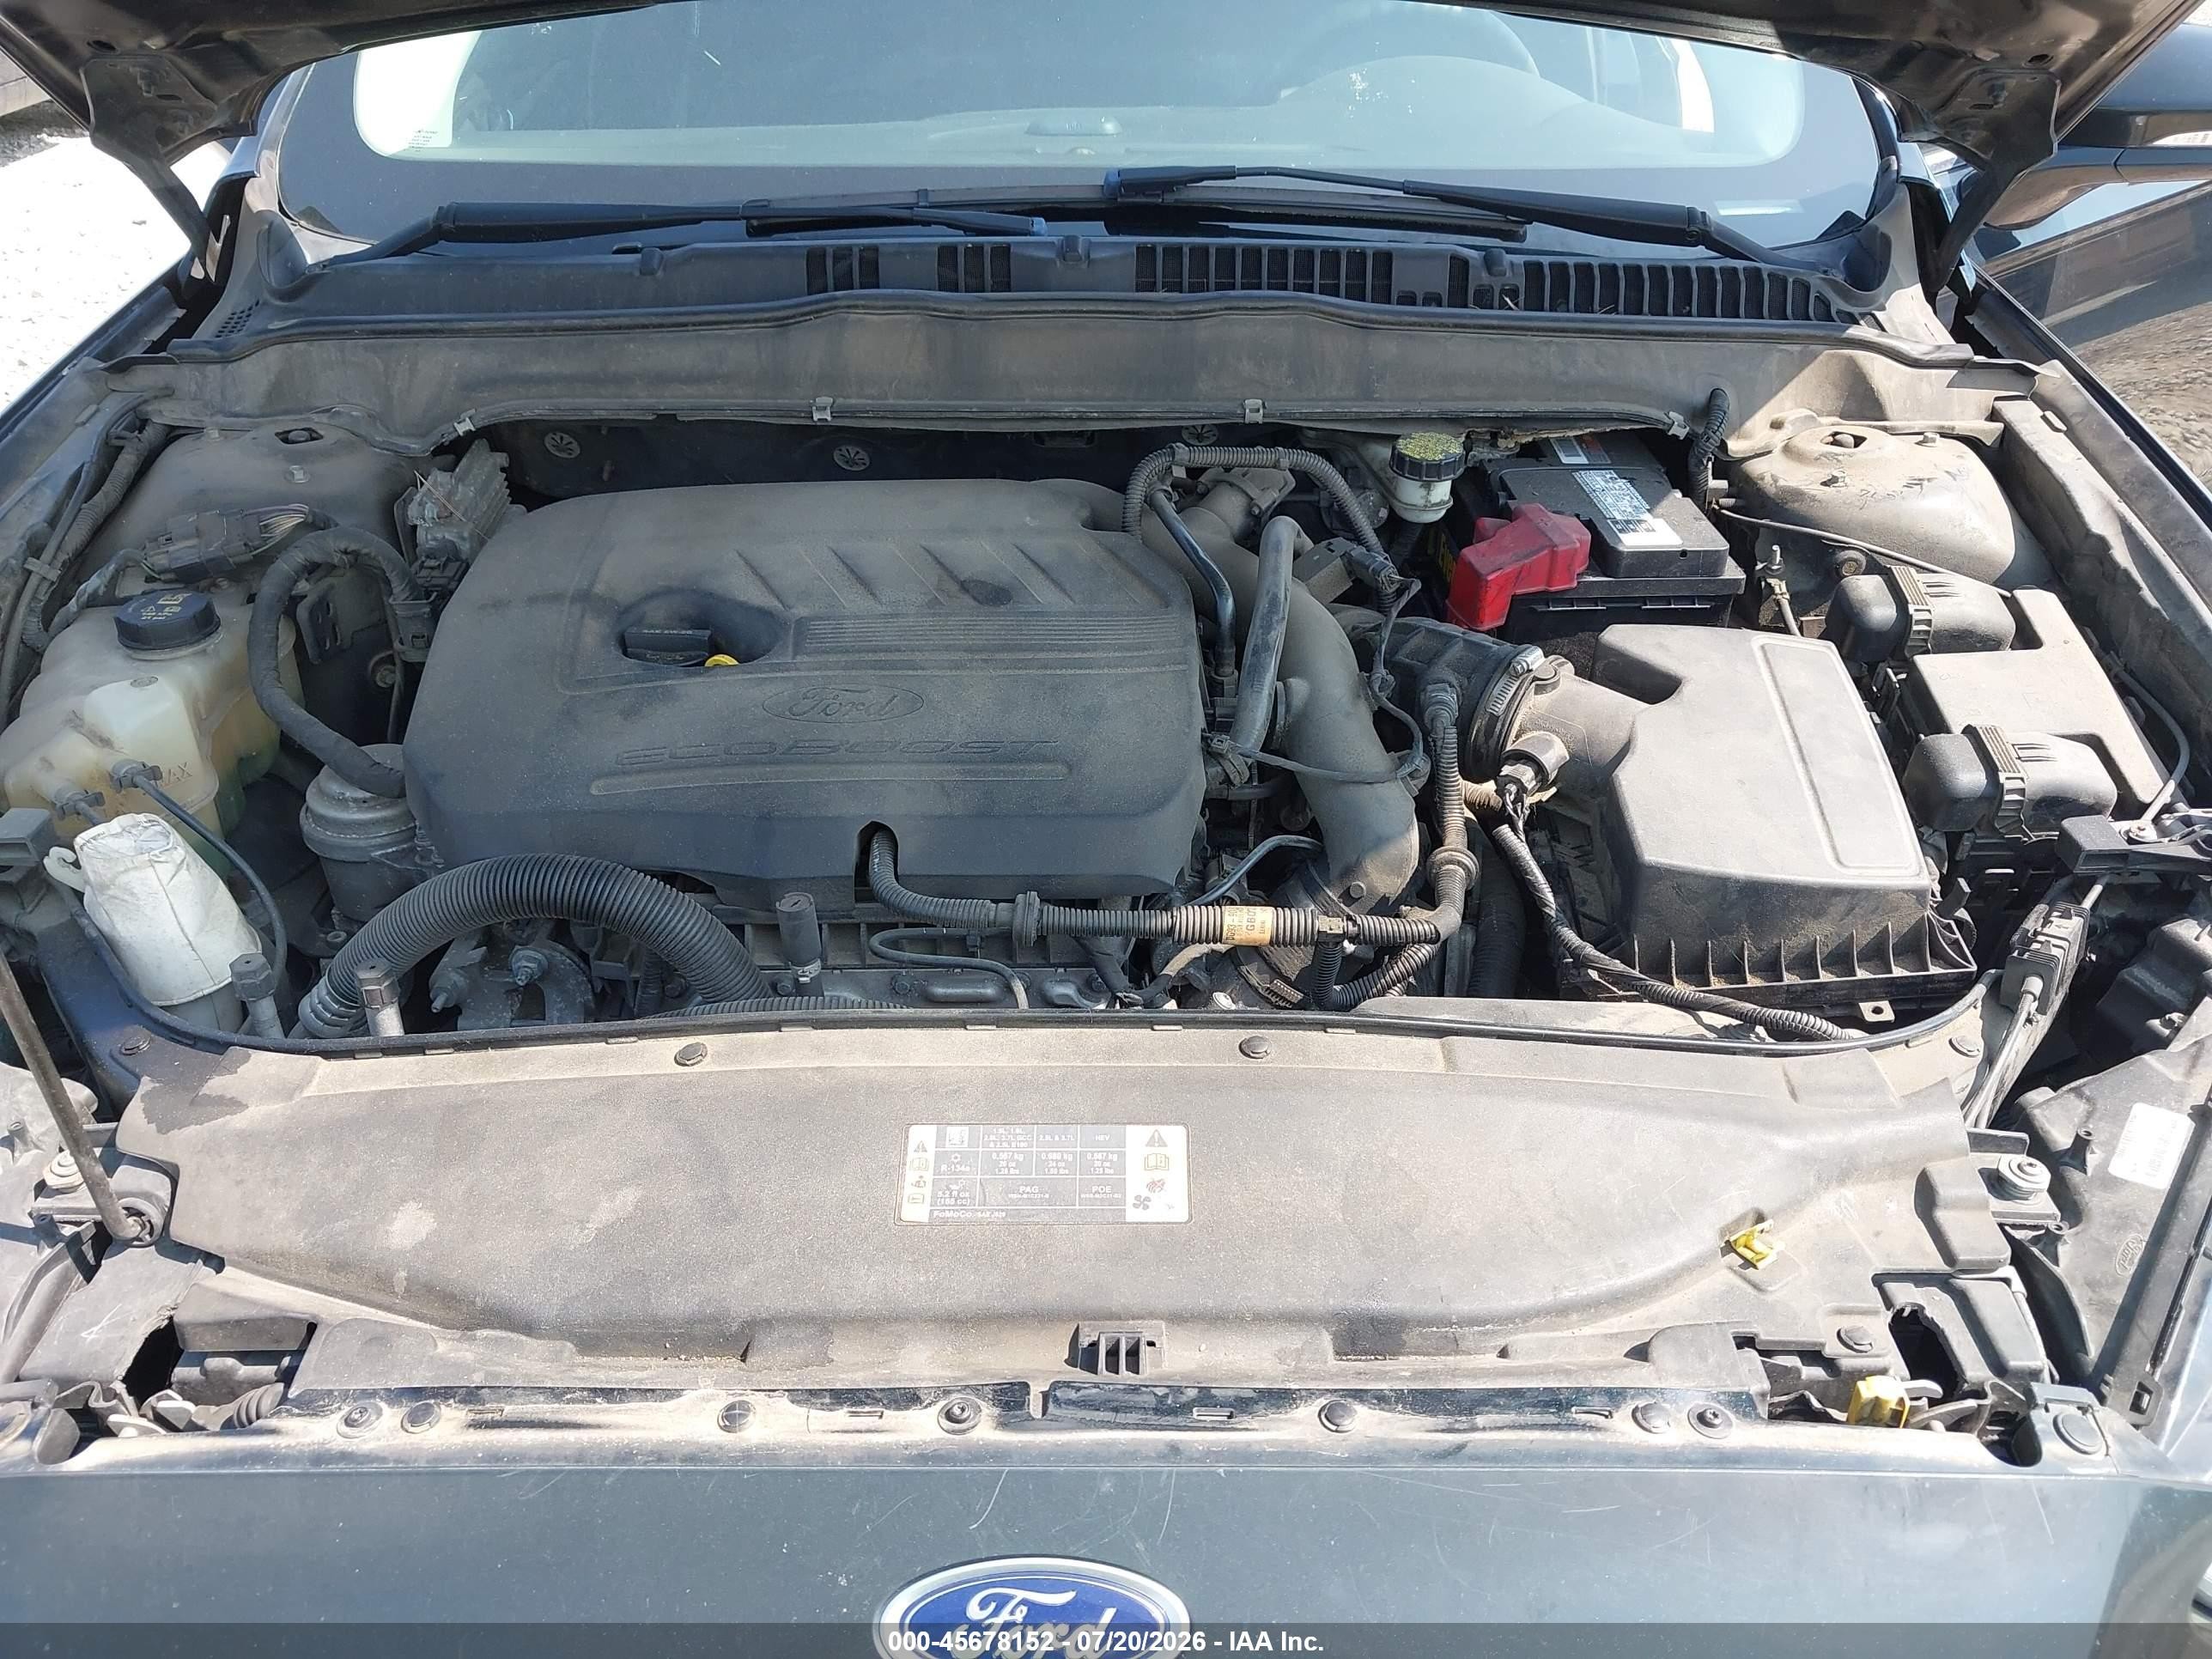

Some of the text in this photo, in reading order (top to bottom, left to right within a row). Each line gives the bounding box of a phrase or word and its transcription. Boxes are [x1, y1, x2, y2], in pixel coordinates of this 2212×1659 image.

[789, 687, 899, 717] Ford
[1013, 1152, 1024, 1162] kg
[1063, 1152, 1073, 1162] kg
[1108, 1152, 1118, 1162] kg
[951, 1587, 1118, 1659] Ford
